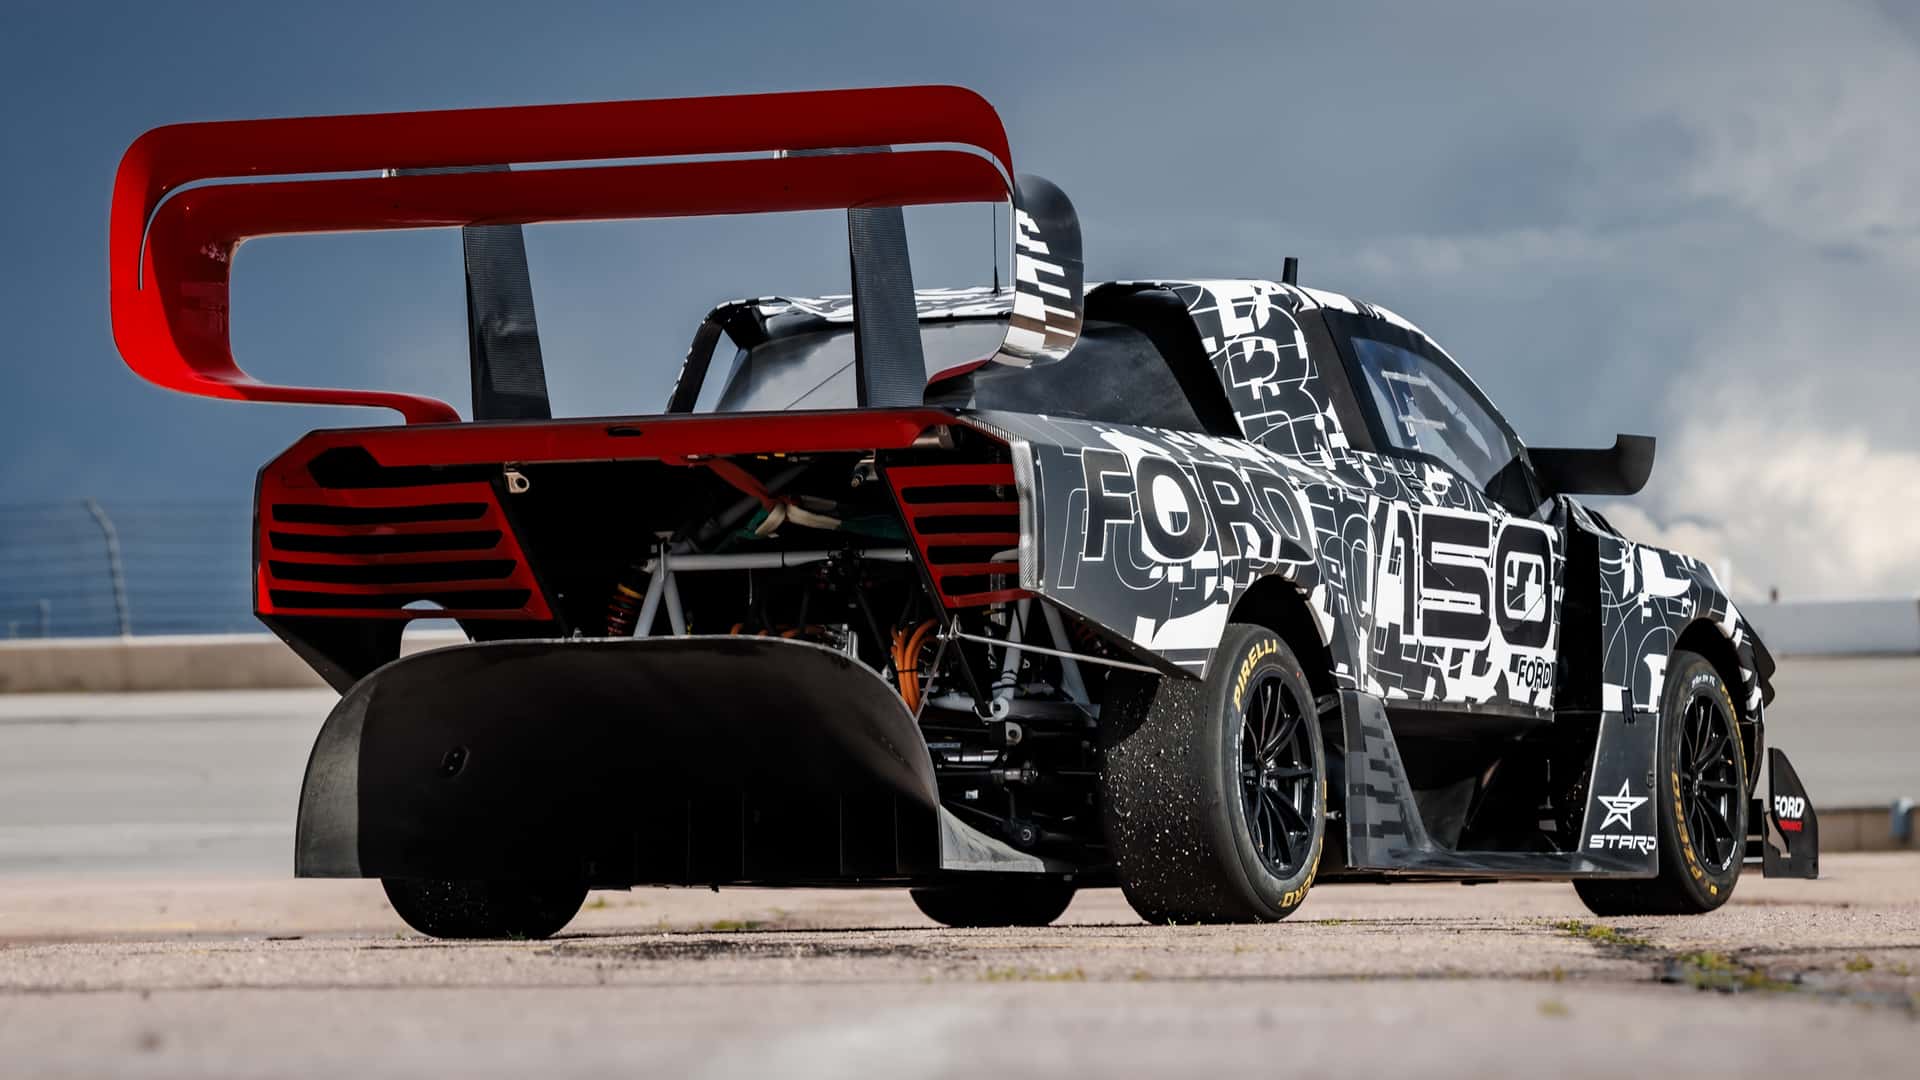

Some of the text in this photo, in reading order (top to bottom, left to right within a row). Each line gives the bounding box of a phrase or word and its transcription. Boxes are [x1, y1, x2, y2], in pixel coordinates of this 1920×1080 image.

[1081, 448, 1315, 564] FORD
[1393, 500, 1556, 651] 150
[1233, 639, 1277, 713] PIRELLI
[1516, 659, 1552, 689] FORD
[1775, 795, 1805, 819] FORD
[1589, 834, 1656, 855] STARD
